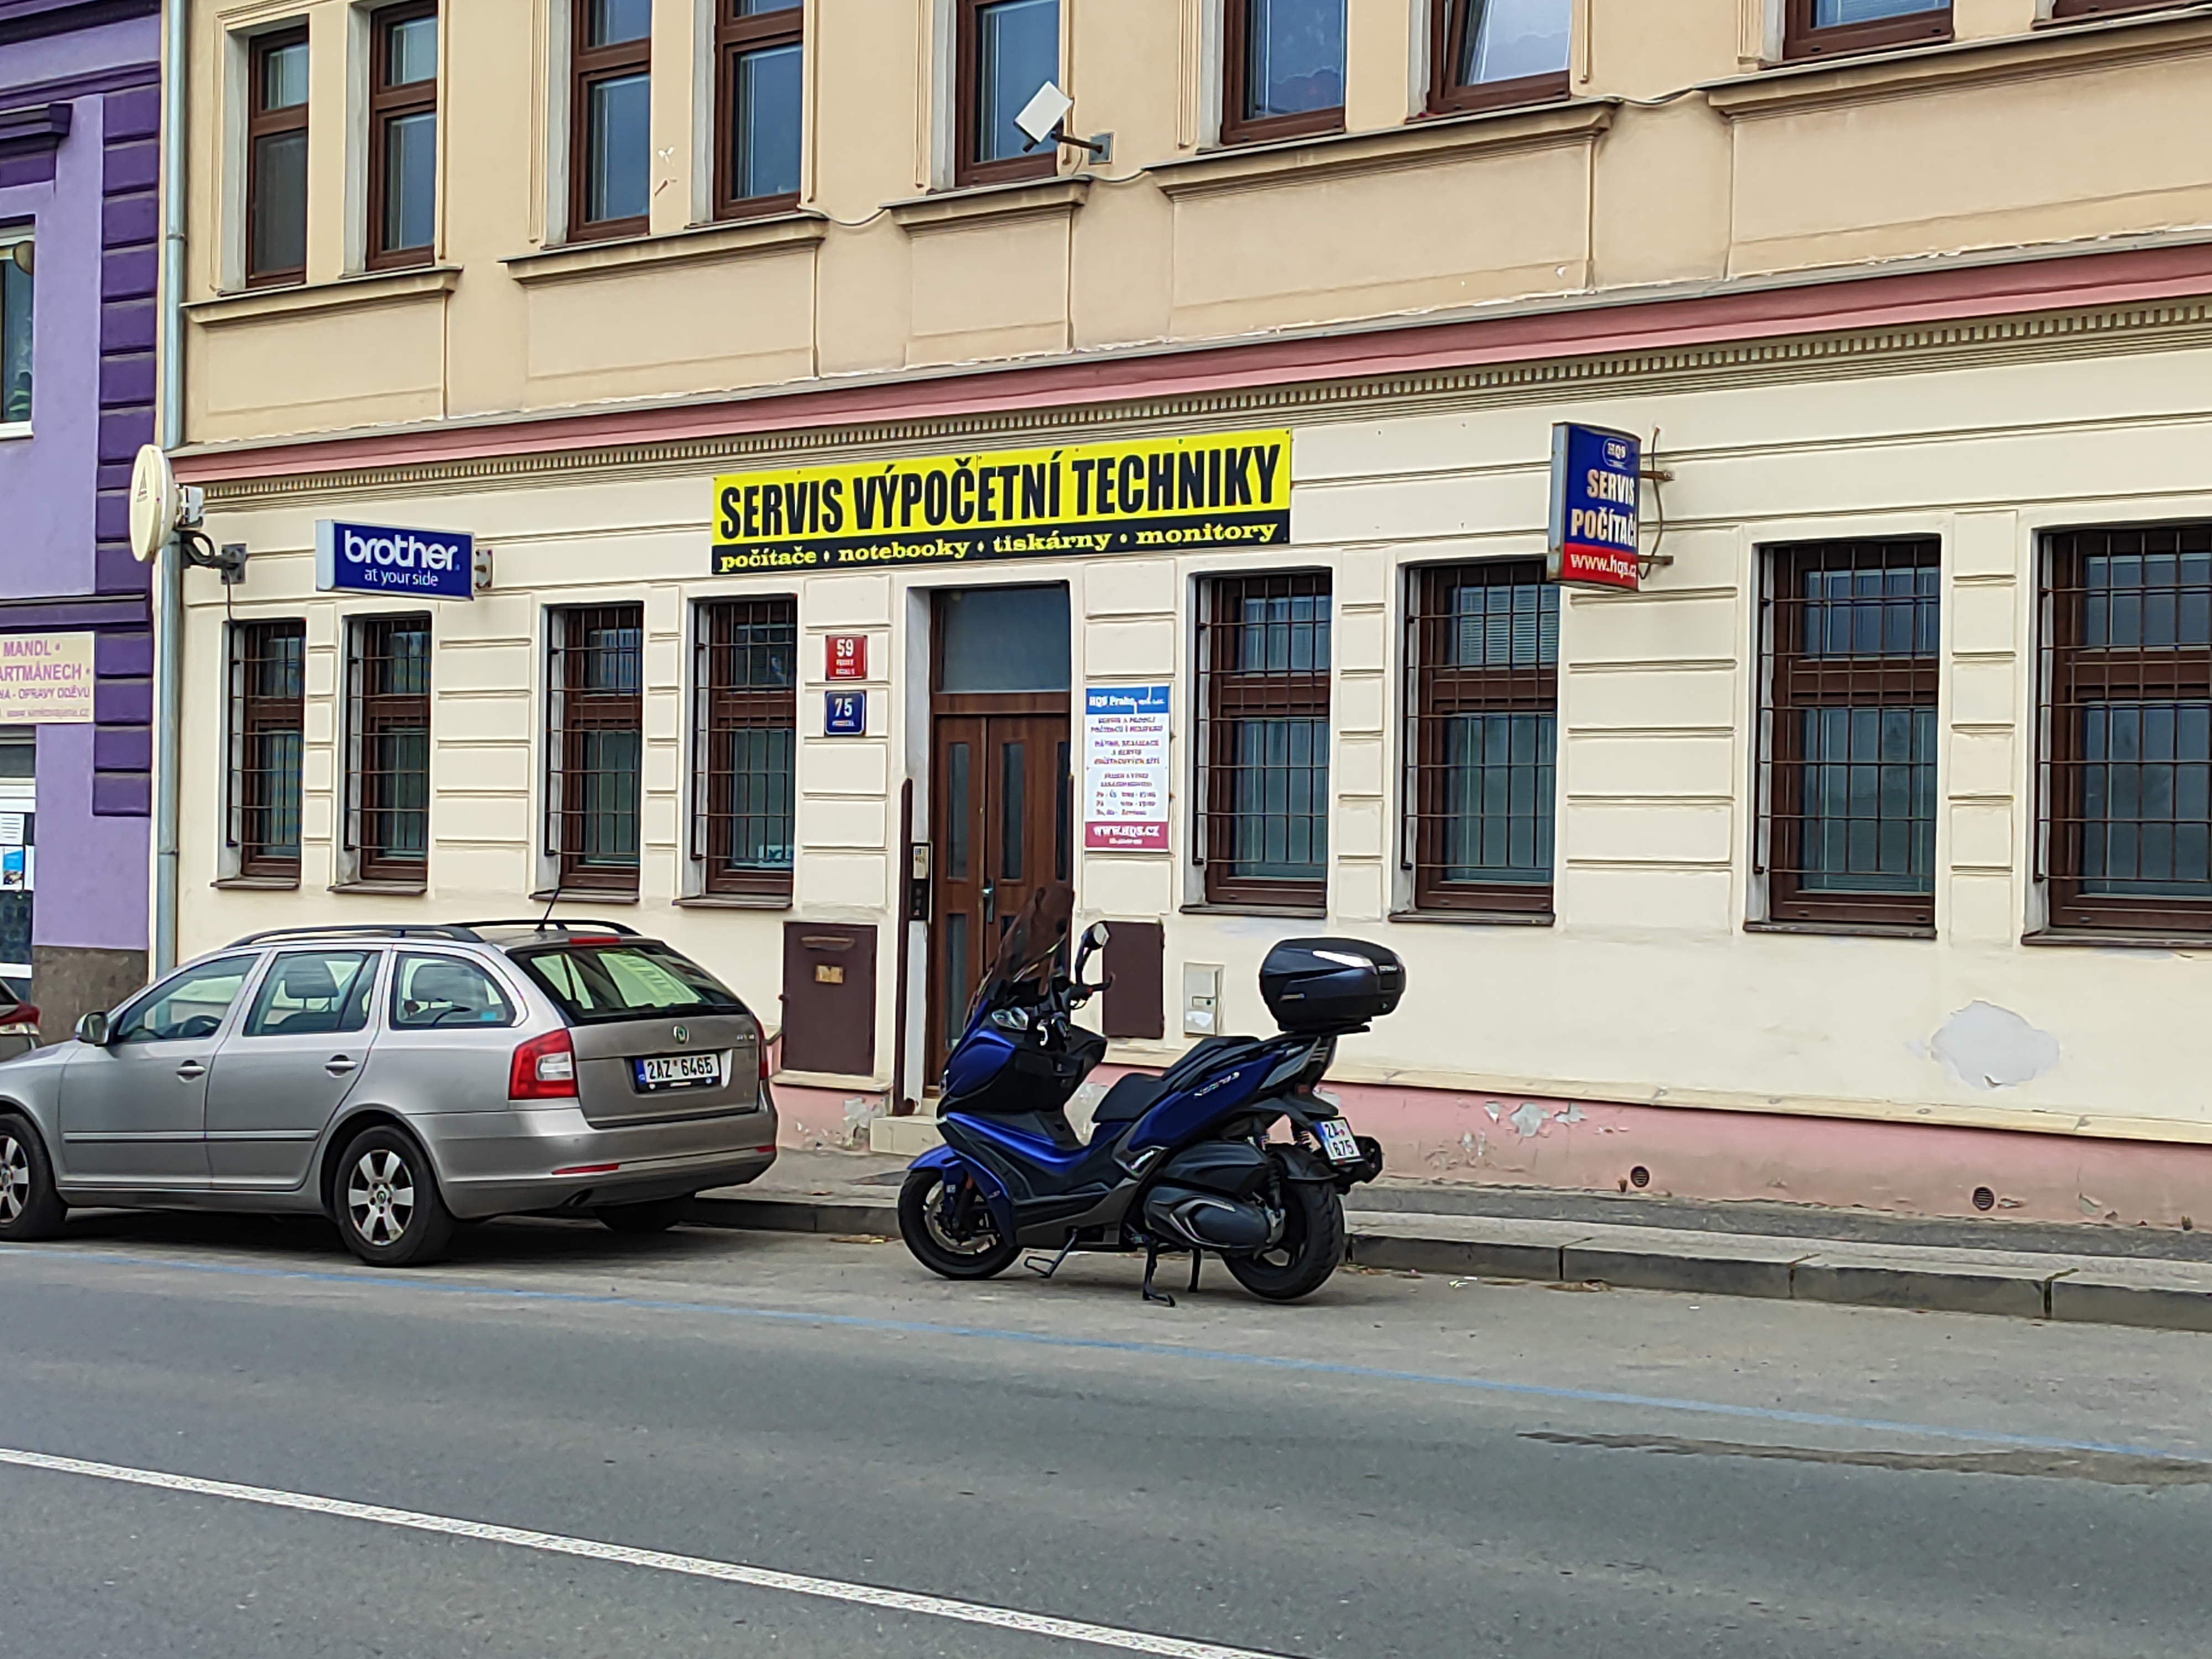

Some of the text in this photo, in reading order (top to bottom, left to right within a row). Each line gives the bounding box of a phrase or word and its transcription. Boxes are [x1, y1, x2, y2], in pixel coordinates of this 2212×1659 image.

[721, 444, 1280, 539] SERVIS VÝPOČETNÍ TECHNIKY
[1587, 469, 1635, 508] SERVIS
[345, 529, 458, 571] brother
[720, 523, 1279, 572] počítače notebooky tiskárny monitory
[364, 568, 439, 586] at your side
[4, 640, 51, 656] MANDL
[837, 639, 854, 657] 59
[835, 698, 853, 717] 75
[648, 1056, 713, 1079] 2AZ 6465
